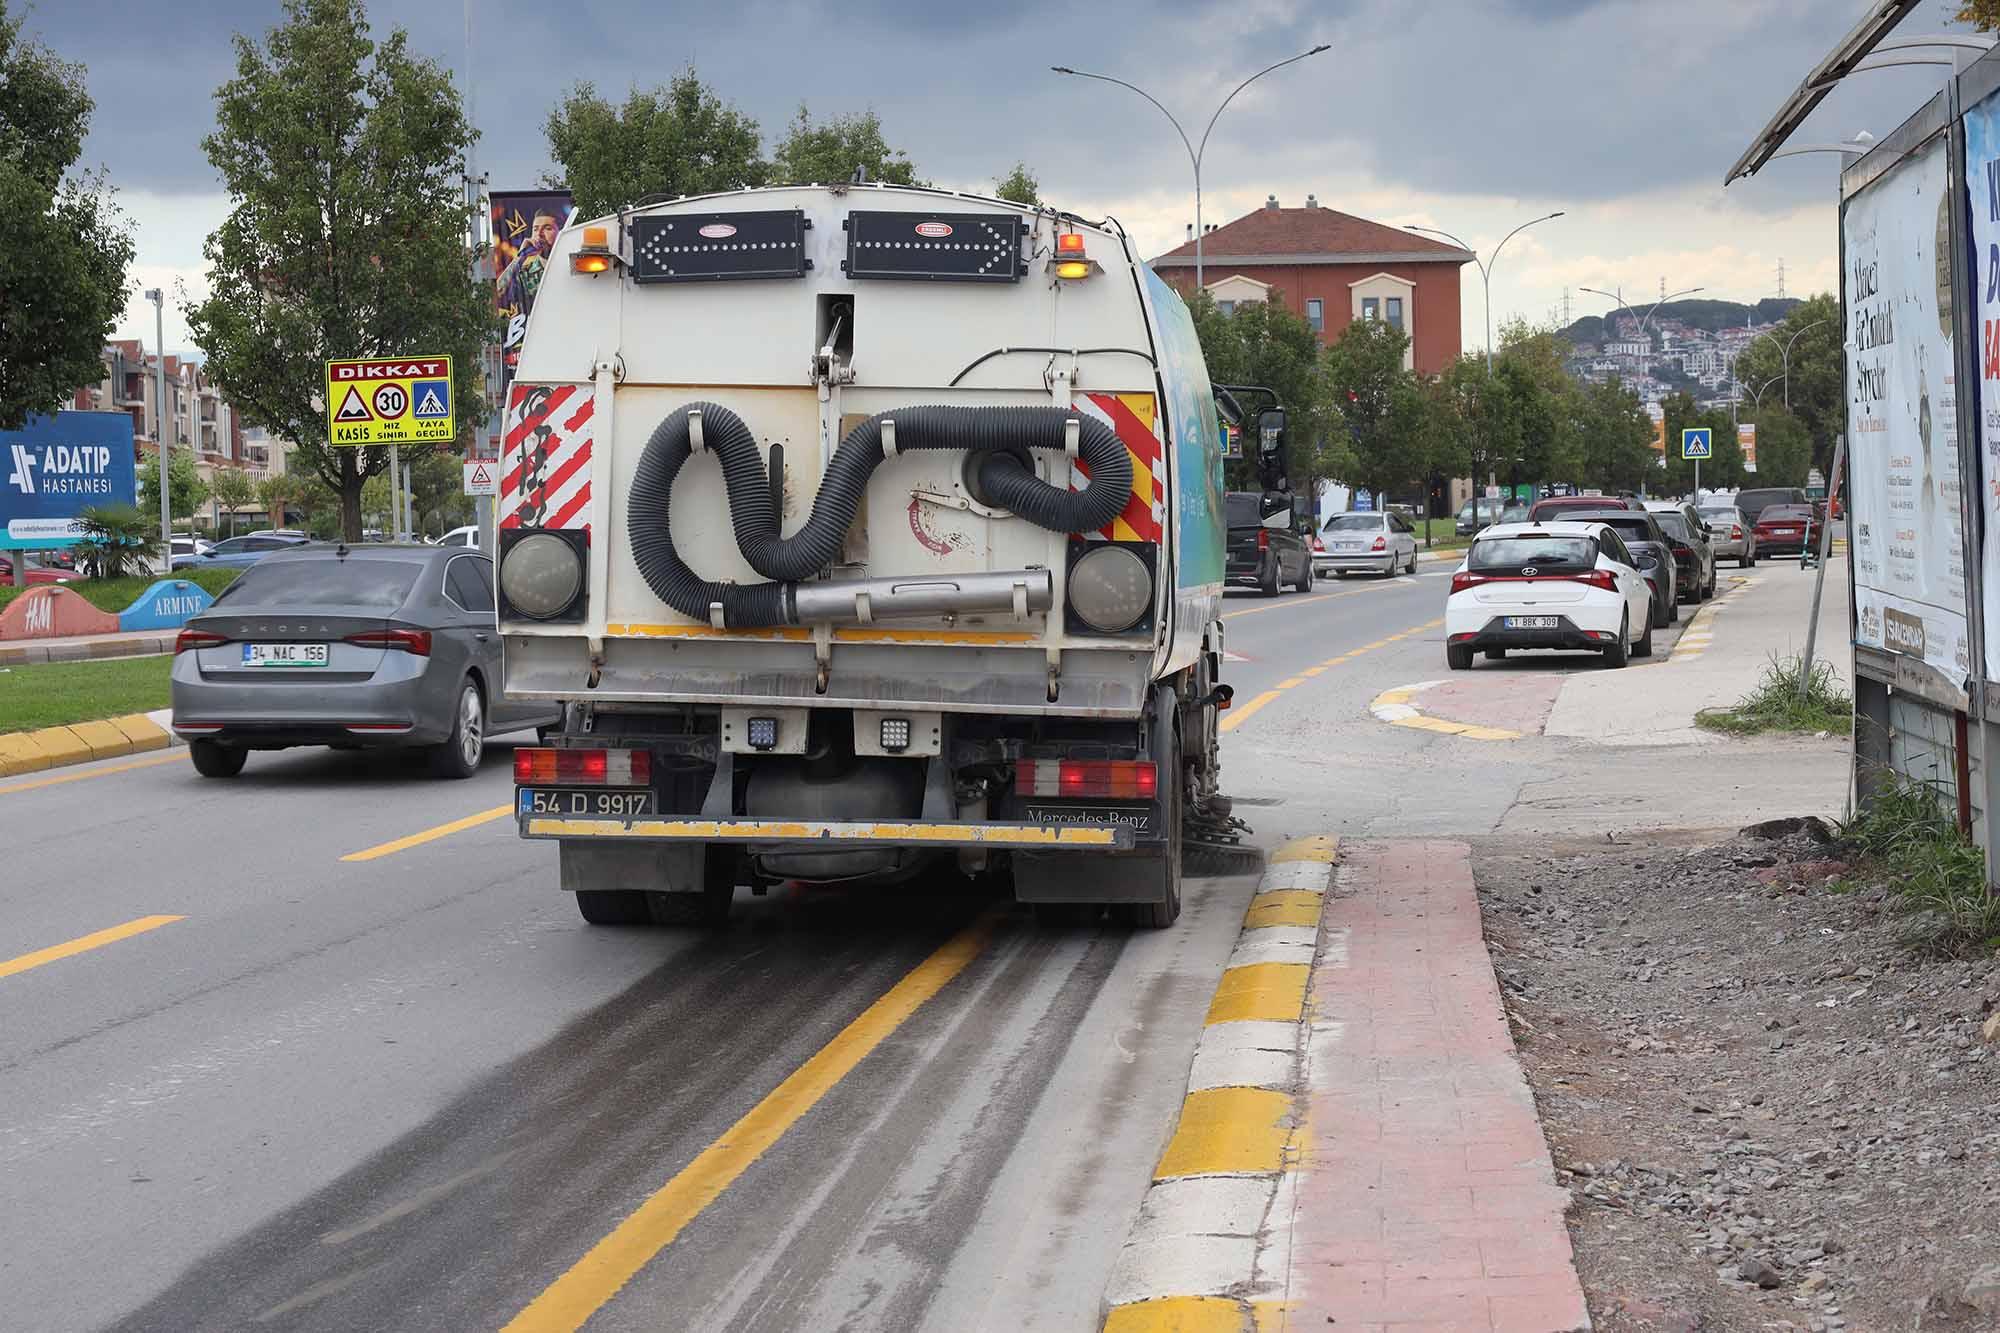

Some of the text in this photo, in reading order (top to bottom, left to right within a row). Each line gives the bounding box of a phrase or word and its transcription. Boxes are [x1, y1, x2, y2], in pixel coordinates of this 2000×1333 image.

[339, 363, 439, 378] DİKKAT
[379, 391, 402, 411] 30
[384, 422, 400, 430] HIZ
[418, 420, 445, 428] YAYA
[337, 424, 370, 441] KASİS
[377, 431, 408, 440] SINIRI
[416, 428, 449, 438] GEÇİDİ
[43, 445, 111, 474] ADATIP
[43, 478, 112, 493] HASTANESİ
[1508, 617, 1519, 627] 41
[1541, 617, 1557, 626] 309
[252, 645, 325, 660] 34 NAC 156
[533, 792, 647, 815] 54 D 9917
